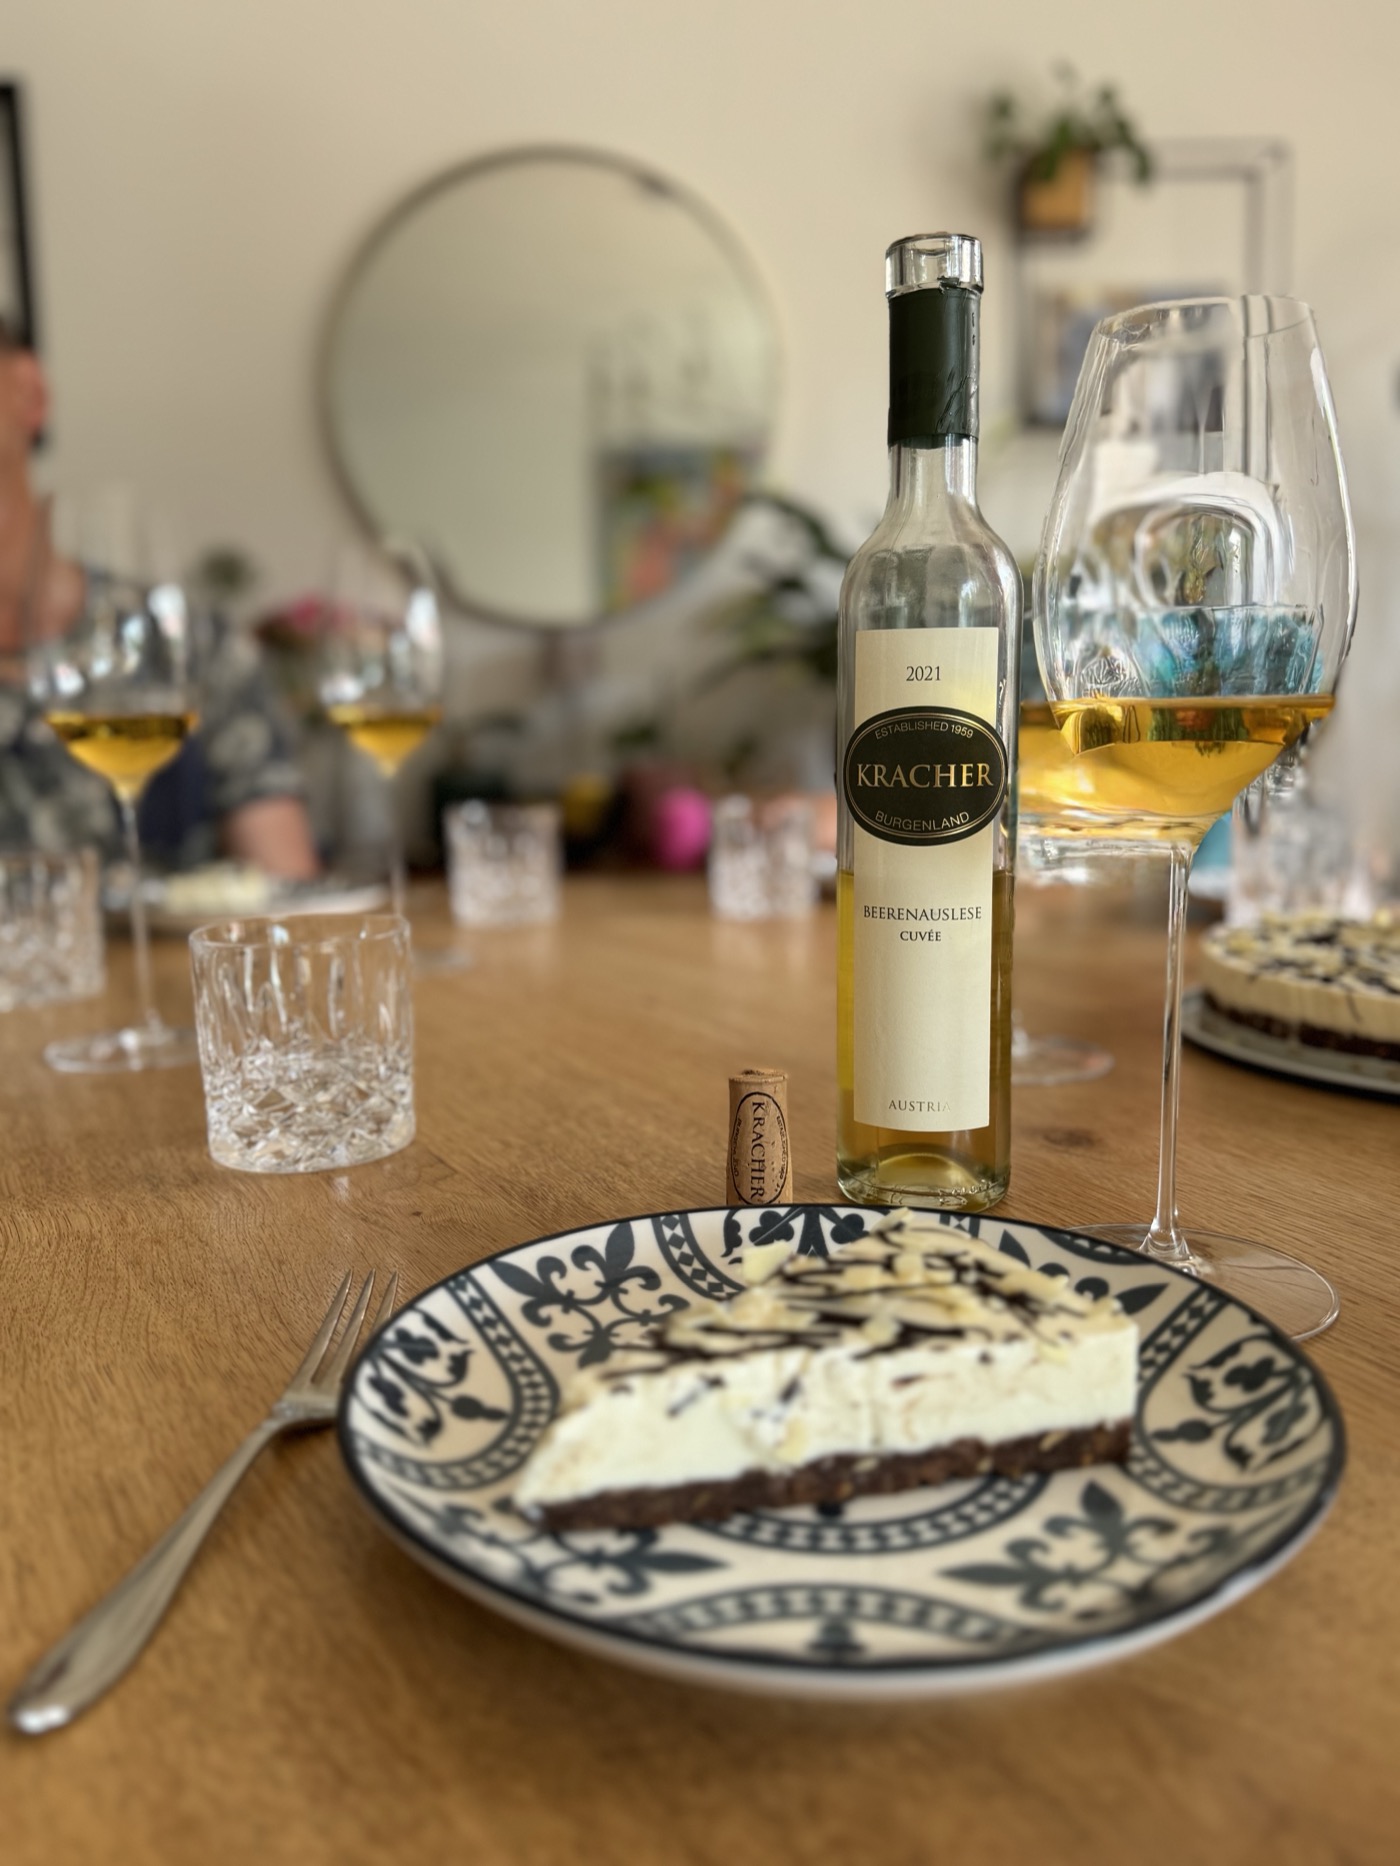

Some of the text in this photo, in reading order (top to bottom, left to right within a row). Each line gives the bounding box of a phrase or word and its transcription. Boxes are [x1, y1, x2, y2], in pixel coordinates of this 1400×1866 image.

[905, 665, 942, 682] 2021
[874, 720, 974, 740] ESTABLISHED 1959
[856, 762, 994, 788] KRACHER
[875, 810, 970, 832] BURGENLAND
[863, 904, 982, 922] BEERENAUSLESE
[899, 929, 942, 942] CUVÉE
[888, 1099, 951, 1113] AUSTRIA
[750, 1101, 766, 1199] KRACHER
